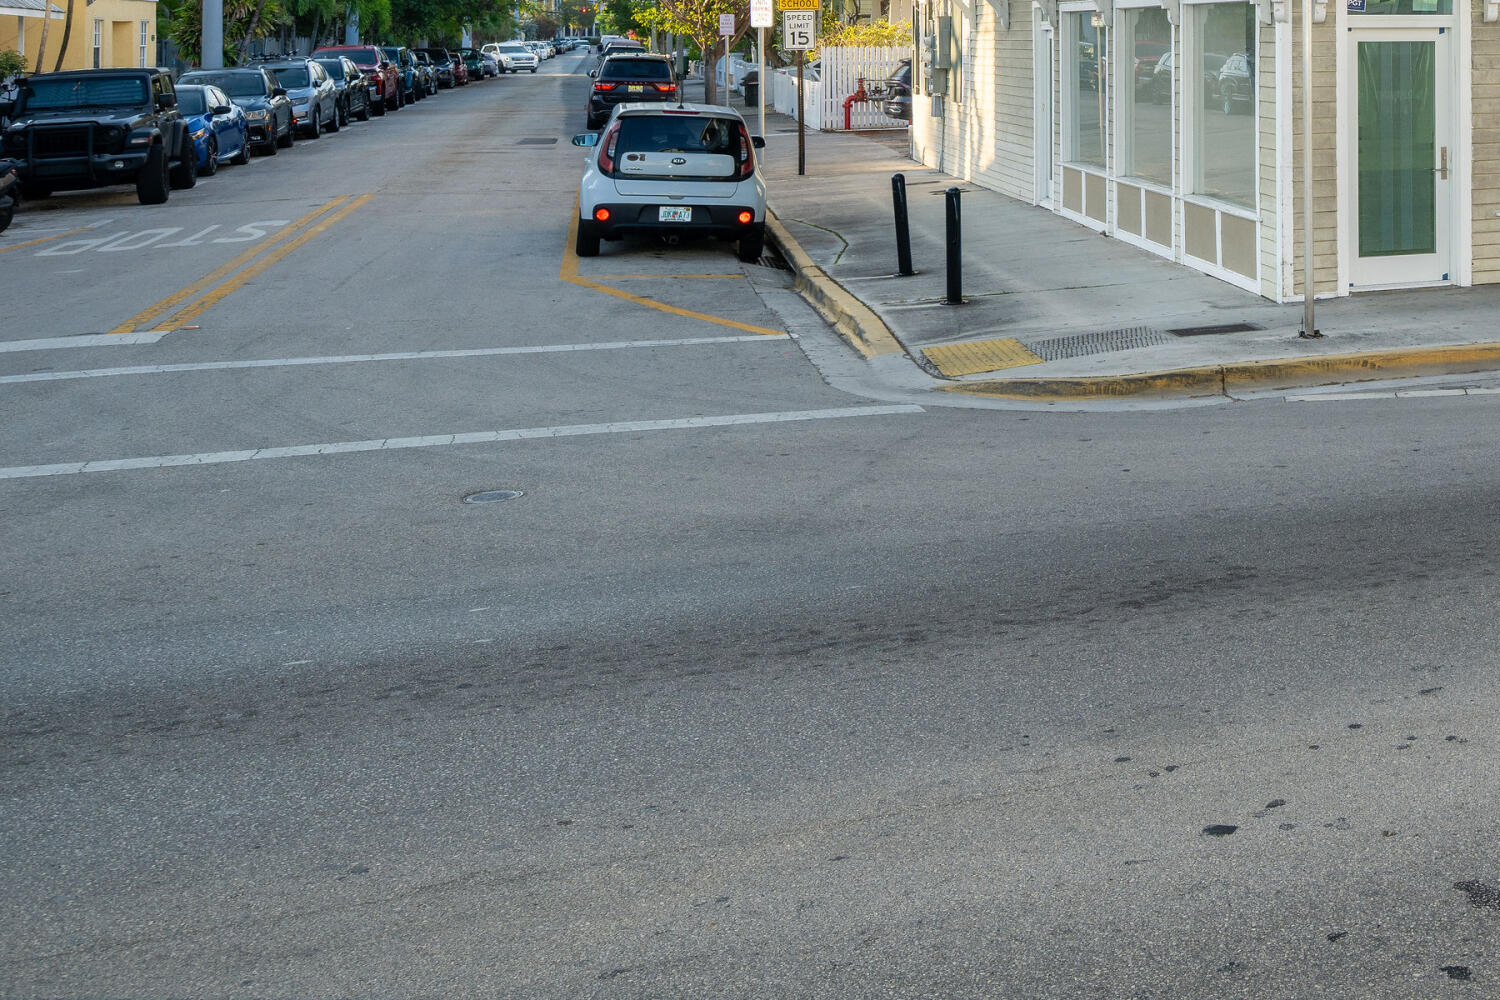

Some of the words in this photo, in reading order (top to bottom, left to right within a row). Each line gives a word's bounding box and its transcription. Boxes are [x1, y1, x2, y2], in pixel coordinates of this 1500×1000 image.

[781, 0, 817, 8] SCHOOL
[1347, 0, 1363, 7] PGT
[790, 31, 810, 46] 15
[33, 220, 291, 256] STOP
